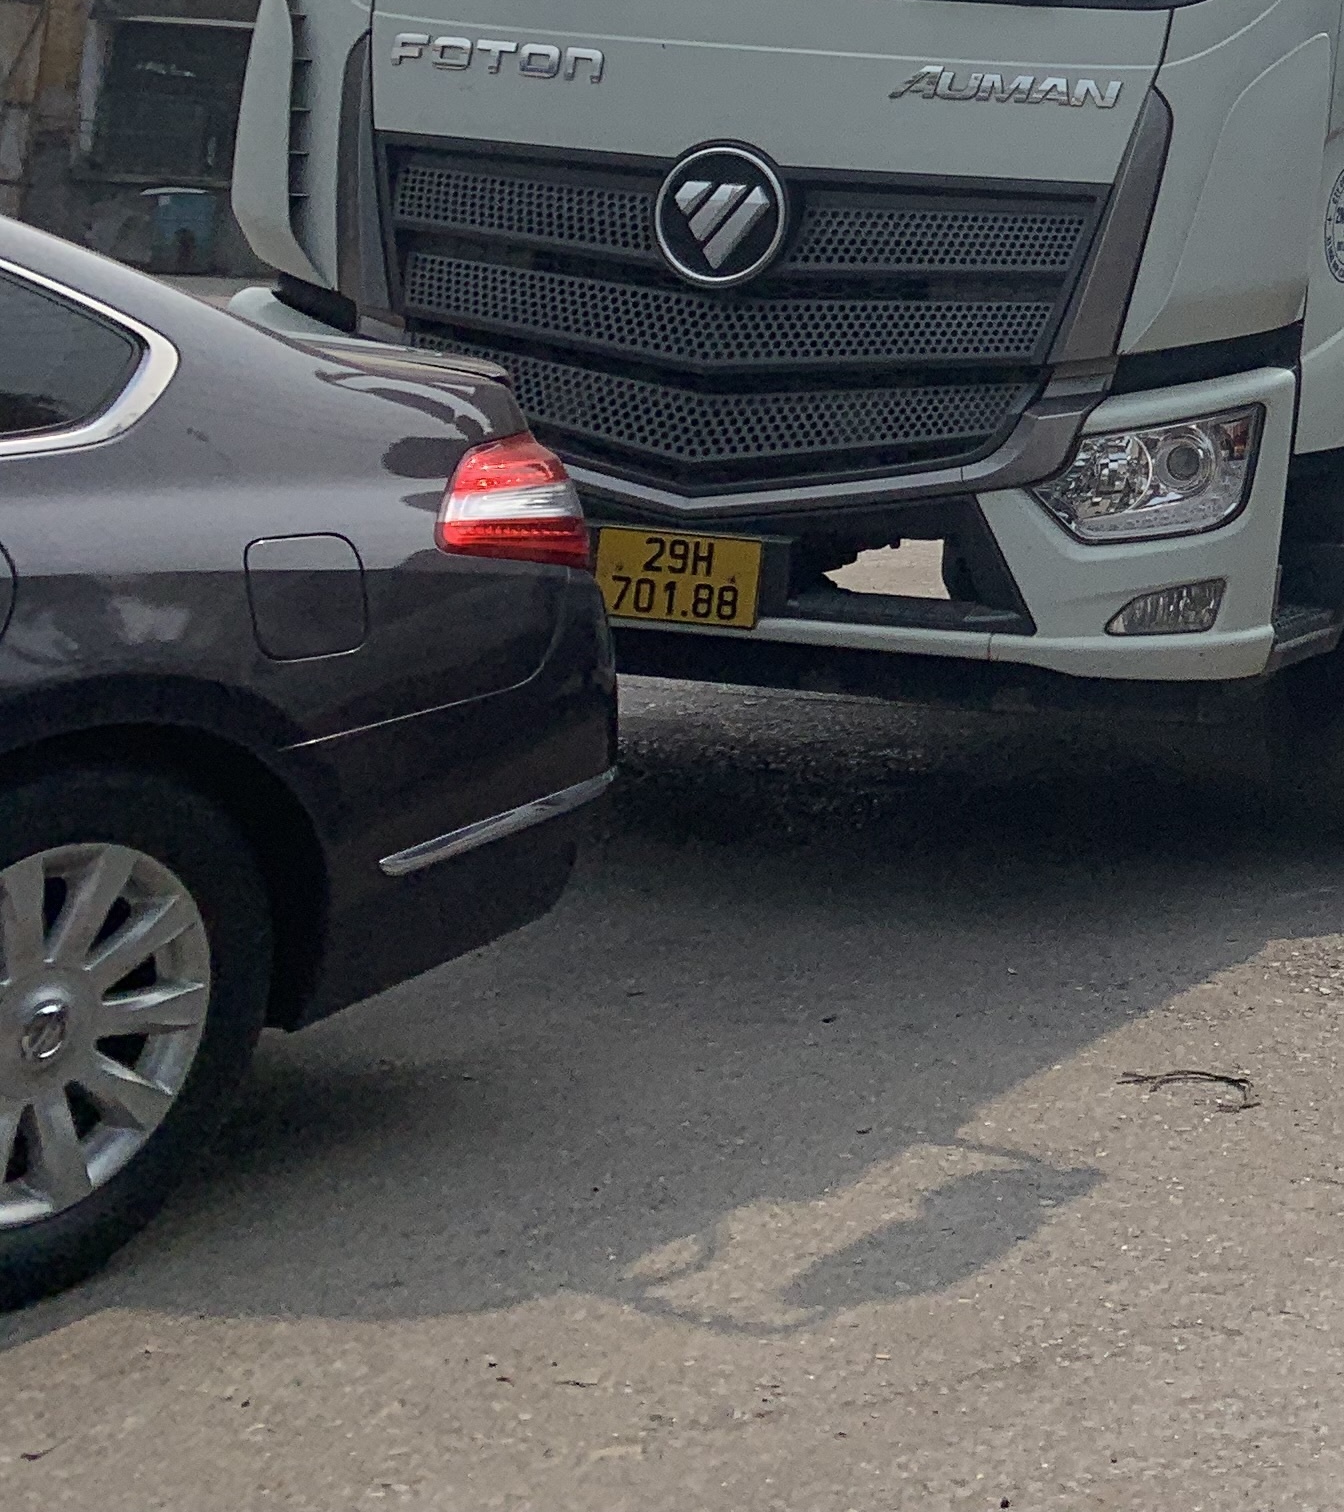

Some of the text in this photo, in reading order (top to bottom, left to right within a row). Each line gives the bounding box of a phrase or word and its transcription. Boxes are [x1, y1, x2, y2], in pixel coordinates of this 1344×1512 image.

[391, 32, 605, 85] FOTON
[888, 64, 1124, 109] AUMAN
[642, 536, 715, 578] 29H
[611, 574, 739, 621] 701.88
